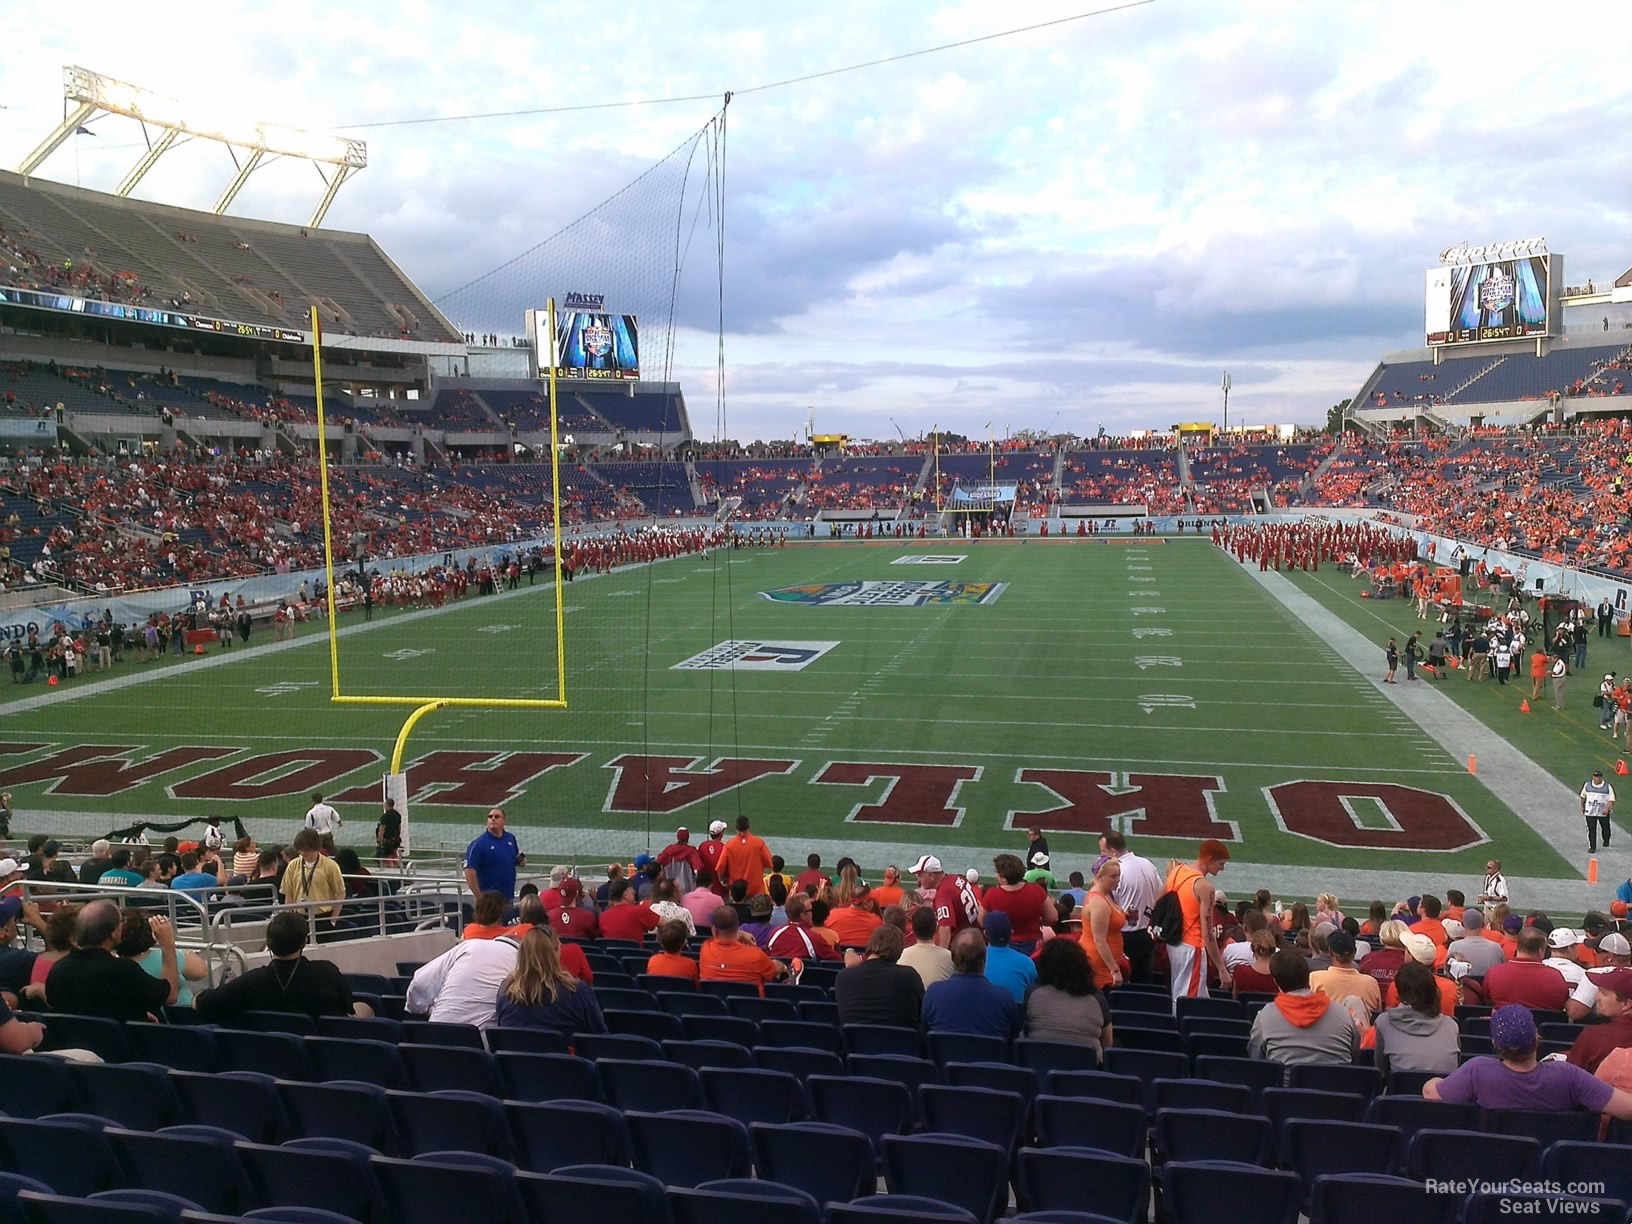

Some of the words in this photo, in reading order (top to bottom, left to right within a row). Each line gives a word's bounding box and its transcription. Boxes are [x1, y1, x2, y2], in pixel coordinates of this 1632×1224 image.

[566, 292, 604, 304] MASSEY
[0, 741, 1493, 854] OKLAHOM
[936, 905, 950, 921] 20
